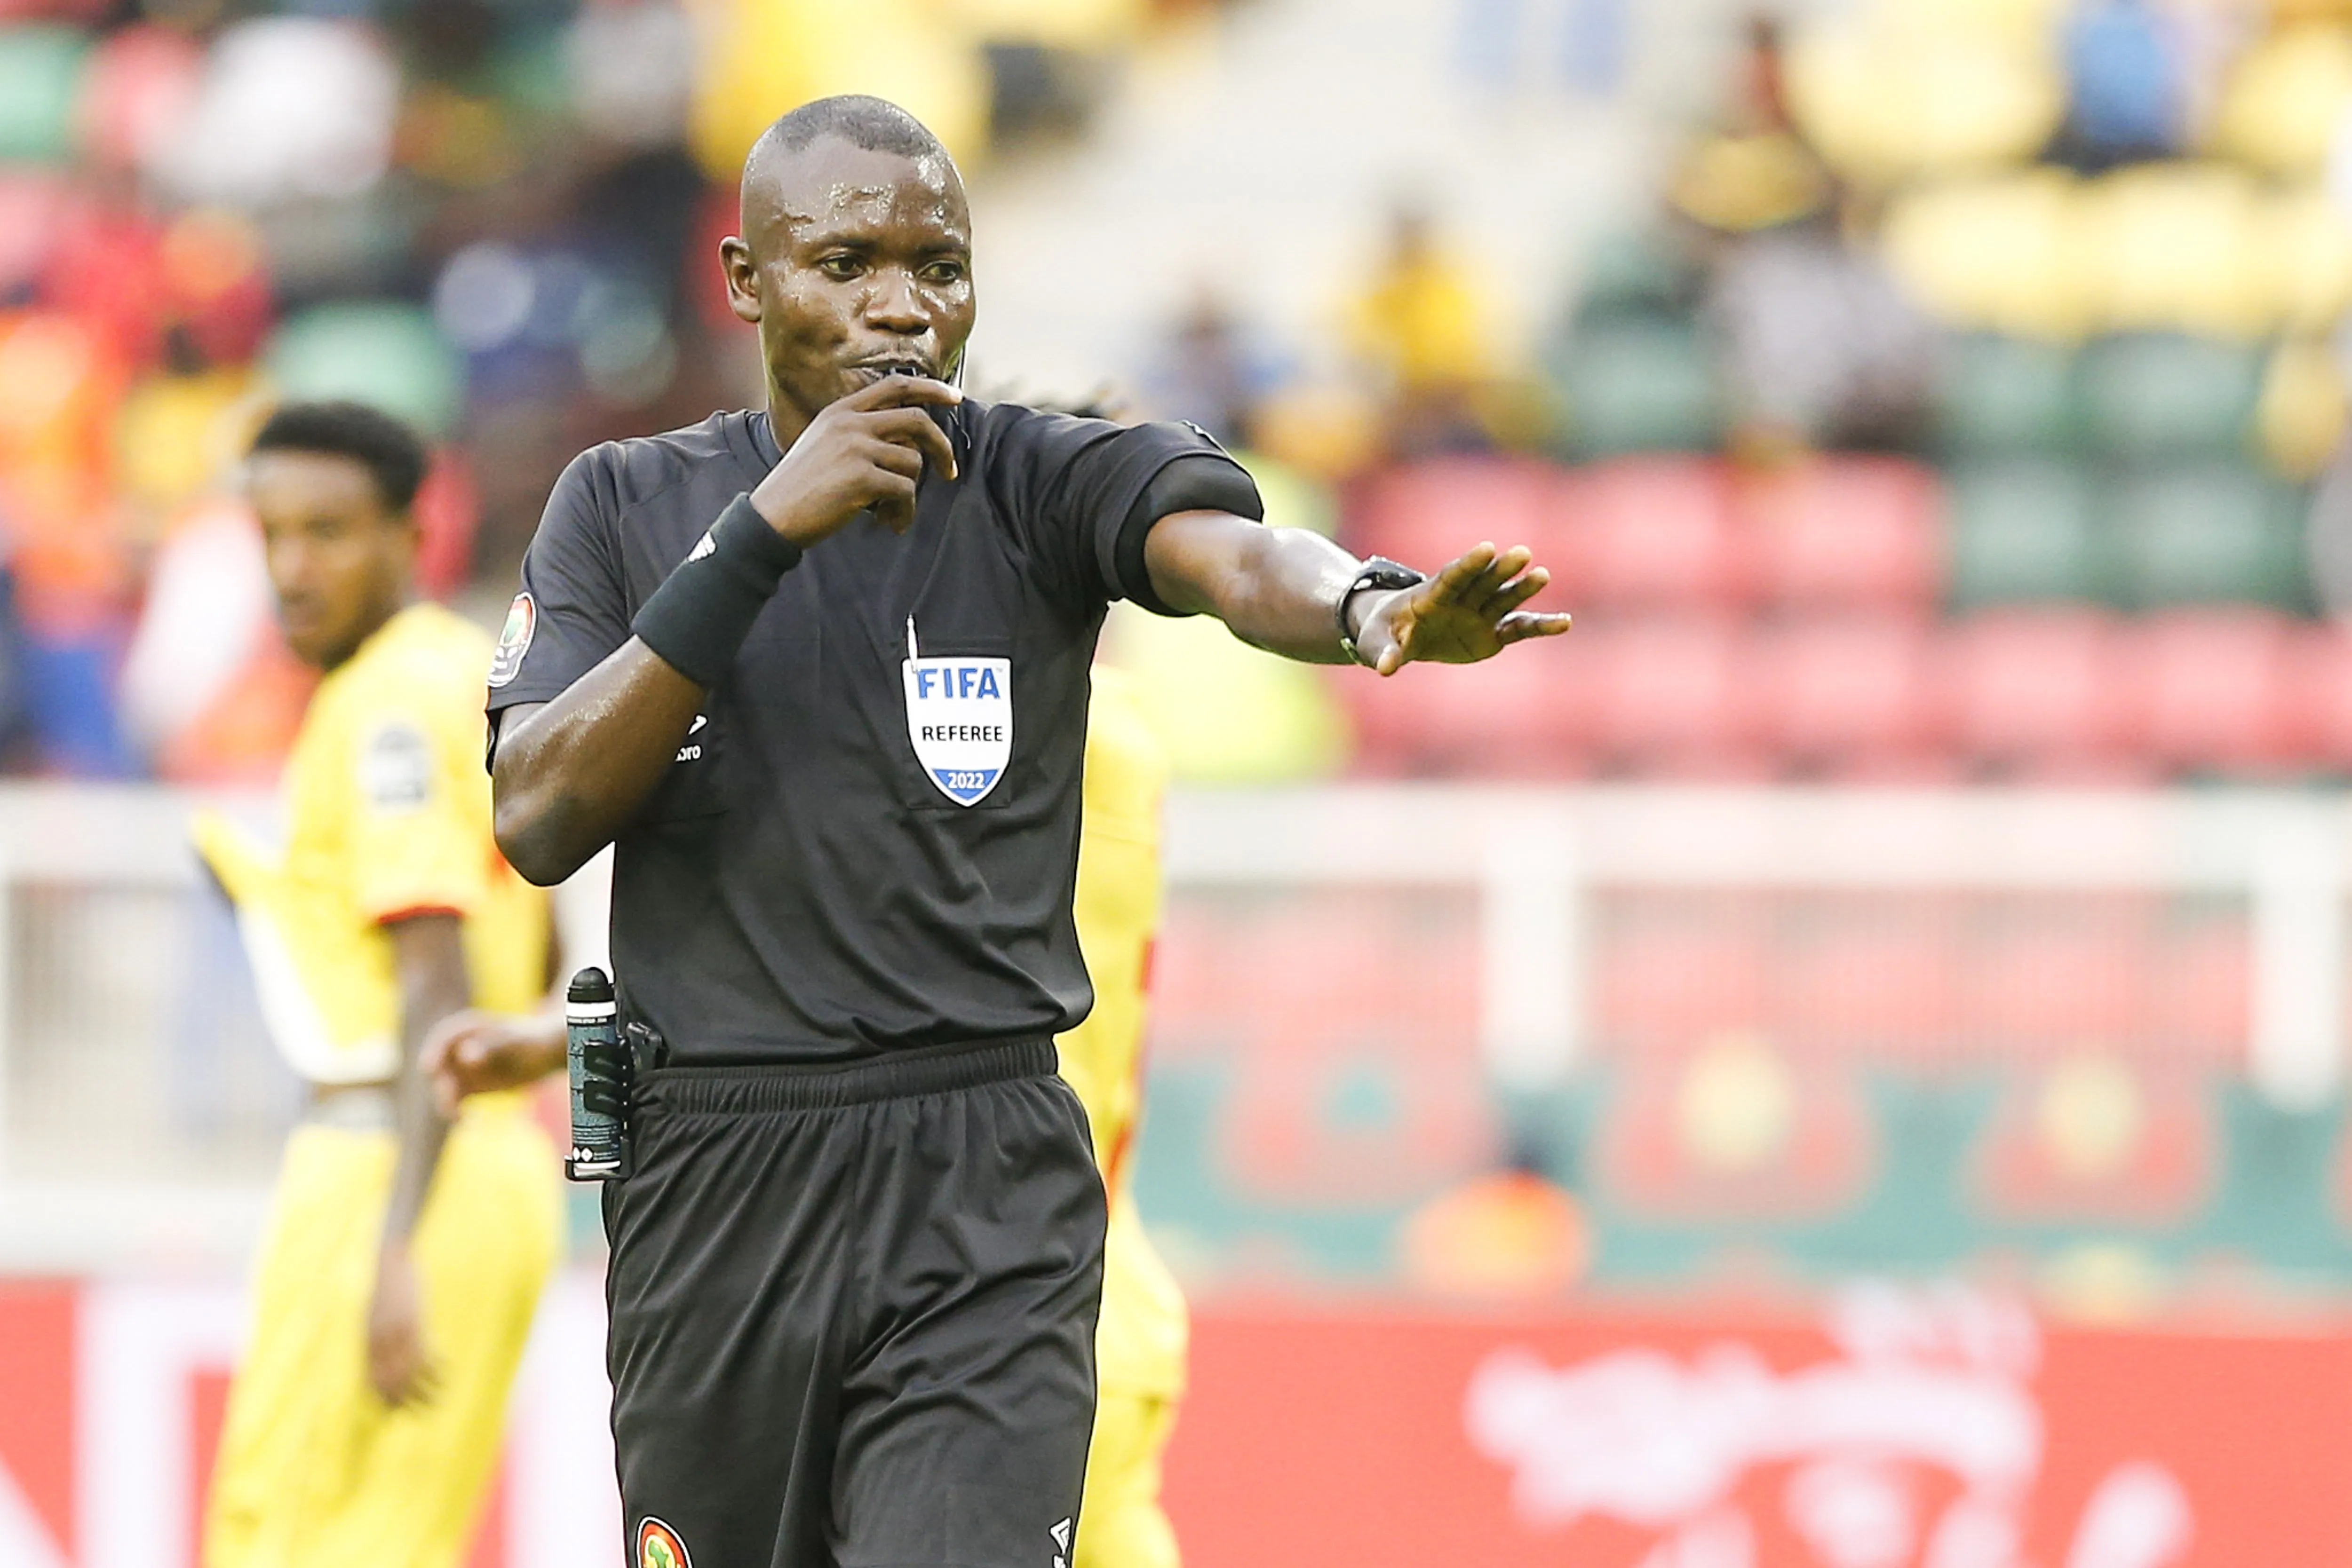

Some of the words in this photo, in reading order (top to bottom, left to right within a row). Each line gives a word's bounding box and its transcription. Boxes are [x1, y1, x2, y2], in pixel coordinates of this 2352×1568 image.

[918, 667, 1000, 698] FIFA
[922, 725, 1003, 742] REFEREE
[947, 772, 985, 789] 2022
